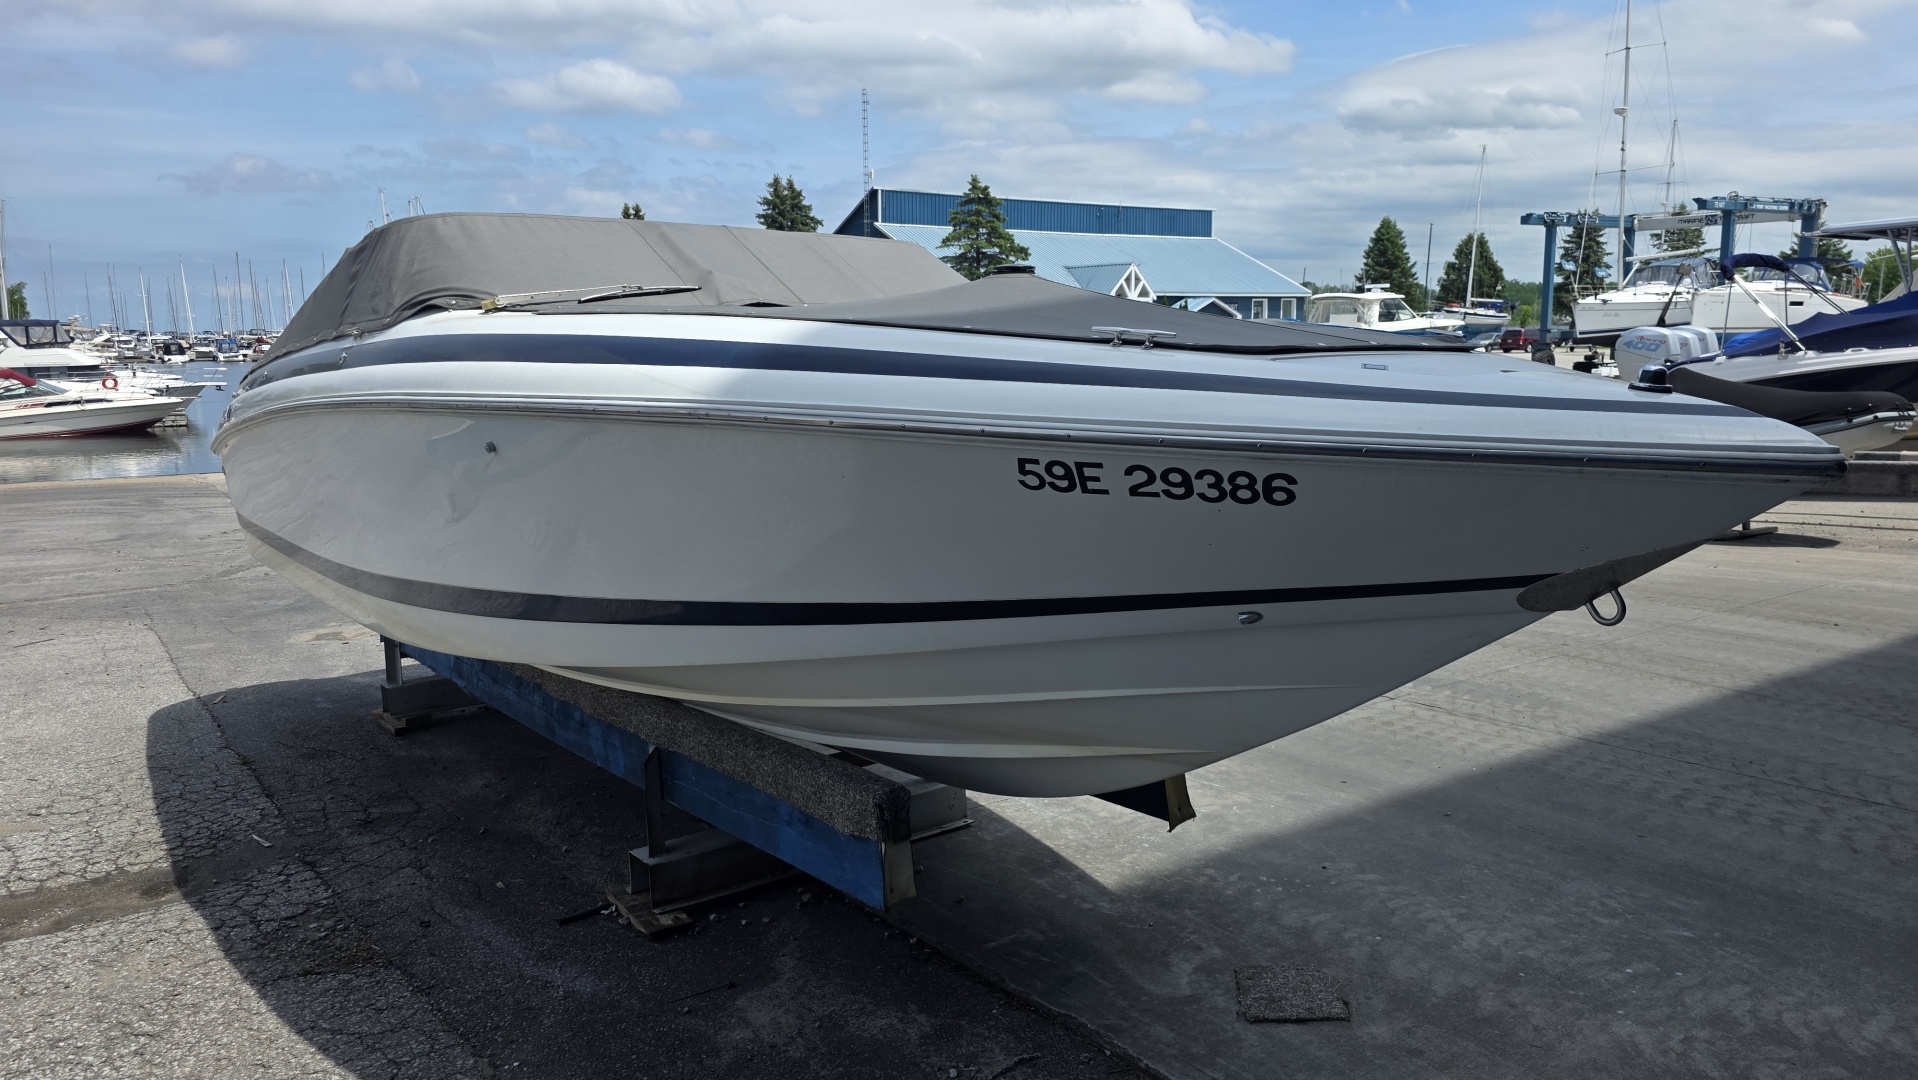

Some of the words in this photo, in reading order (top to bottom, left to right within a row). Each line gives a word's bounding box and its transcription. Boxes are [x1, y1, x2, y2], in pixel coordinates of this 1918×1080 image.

[1623, 340, 1661, 352] 400
[1017, 457, 1110, 495] 59E
[1123, 464, 1298, 506] 29386
